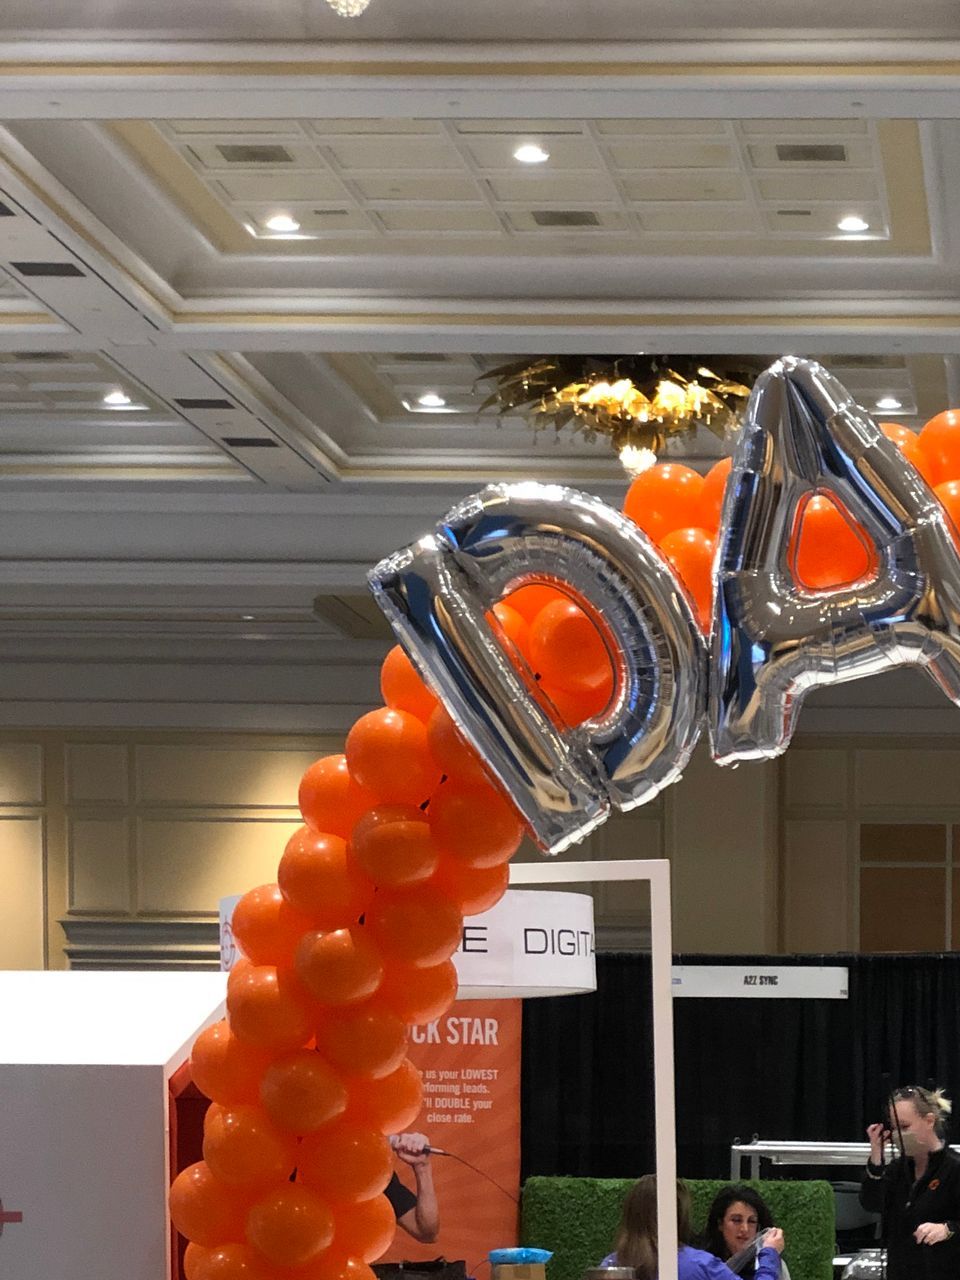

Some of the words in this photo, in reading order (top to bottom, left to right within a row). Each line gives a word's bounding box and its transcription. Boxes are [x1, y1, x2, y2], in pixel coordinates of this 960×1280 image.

[743, 975, 757, 985] A2Z
[759, 975, 779, 985] SYNC
[408, 1018, 441, 1044] CK
[446, 1016, 499, 1046] STAR
[425, 1069, 436, 1081] us
[439, 1069, 459, 1082] your
[461, 1068, 499, 1081] LOWEST
[463, 1082, 490, 1094] leads.
[435, 1097, 470, 1110] DOUBLE
[472, 1099, 494, 1112] your
[426, 1112, 452, 1124] close
[453, 1113, 475, 1124] rate.
